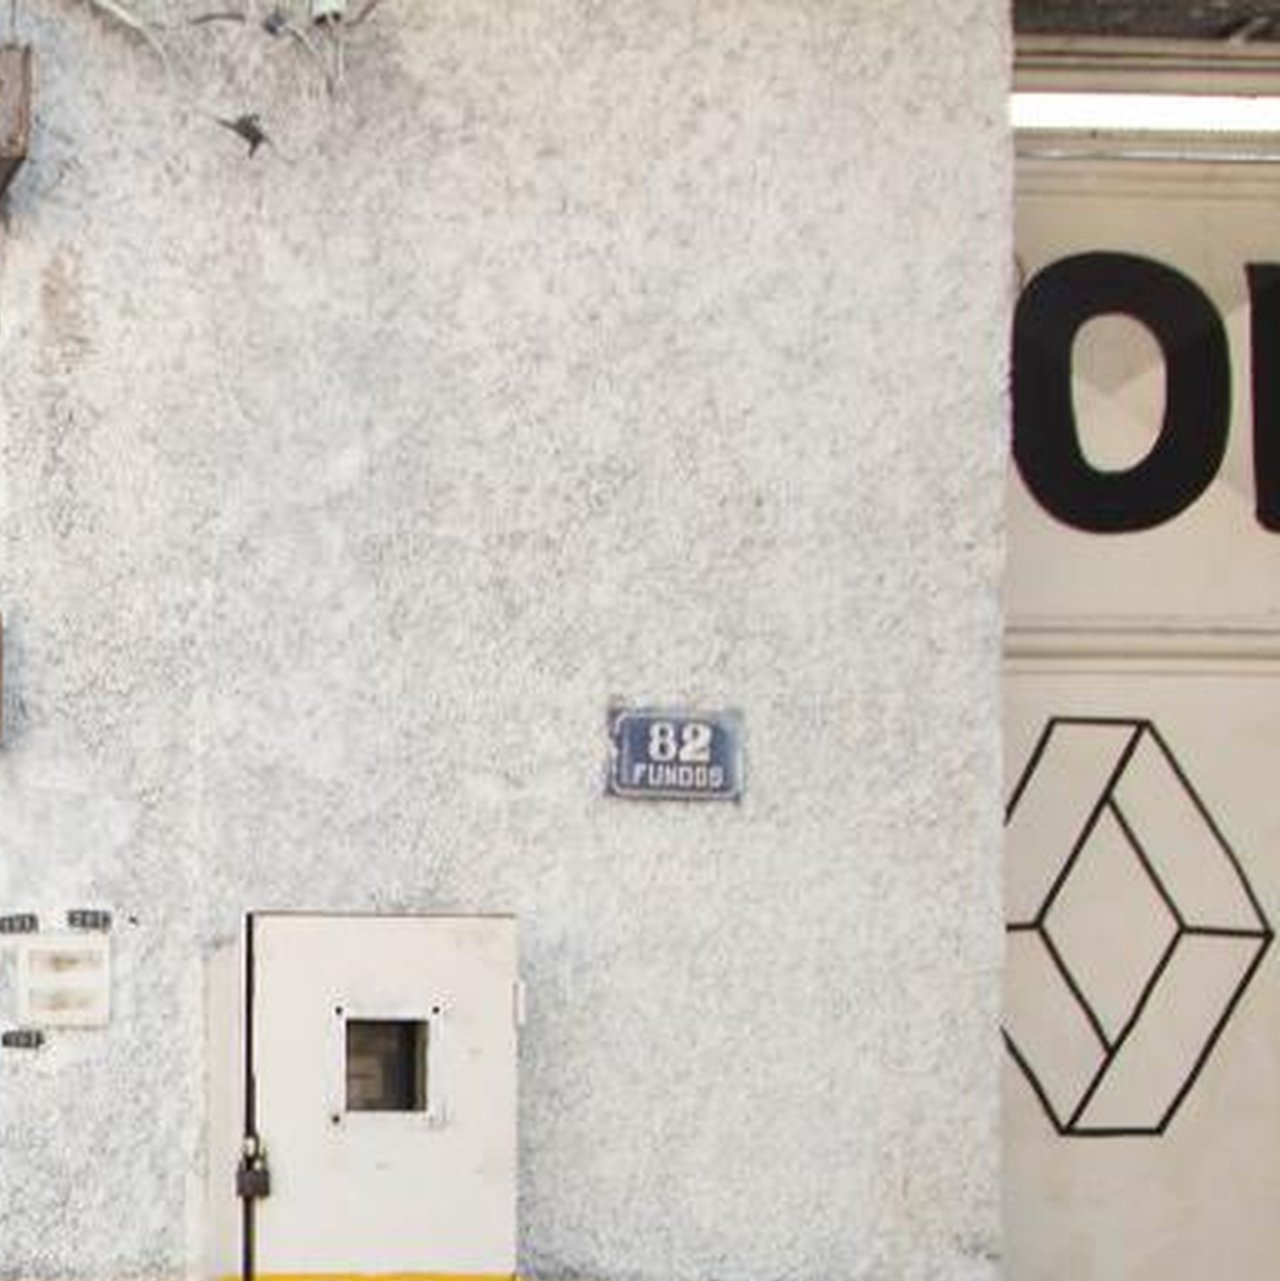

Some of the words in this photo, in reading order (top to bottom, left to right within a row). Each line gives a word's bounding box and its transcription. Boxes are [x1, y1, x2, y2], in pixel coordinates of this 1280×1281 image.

[1011, 250, 1280, 536] O
[648, 722, 712, 762] 82
[632, 763, 724, 788] FUNDOS
